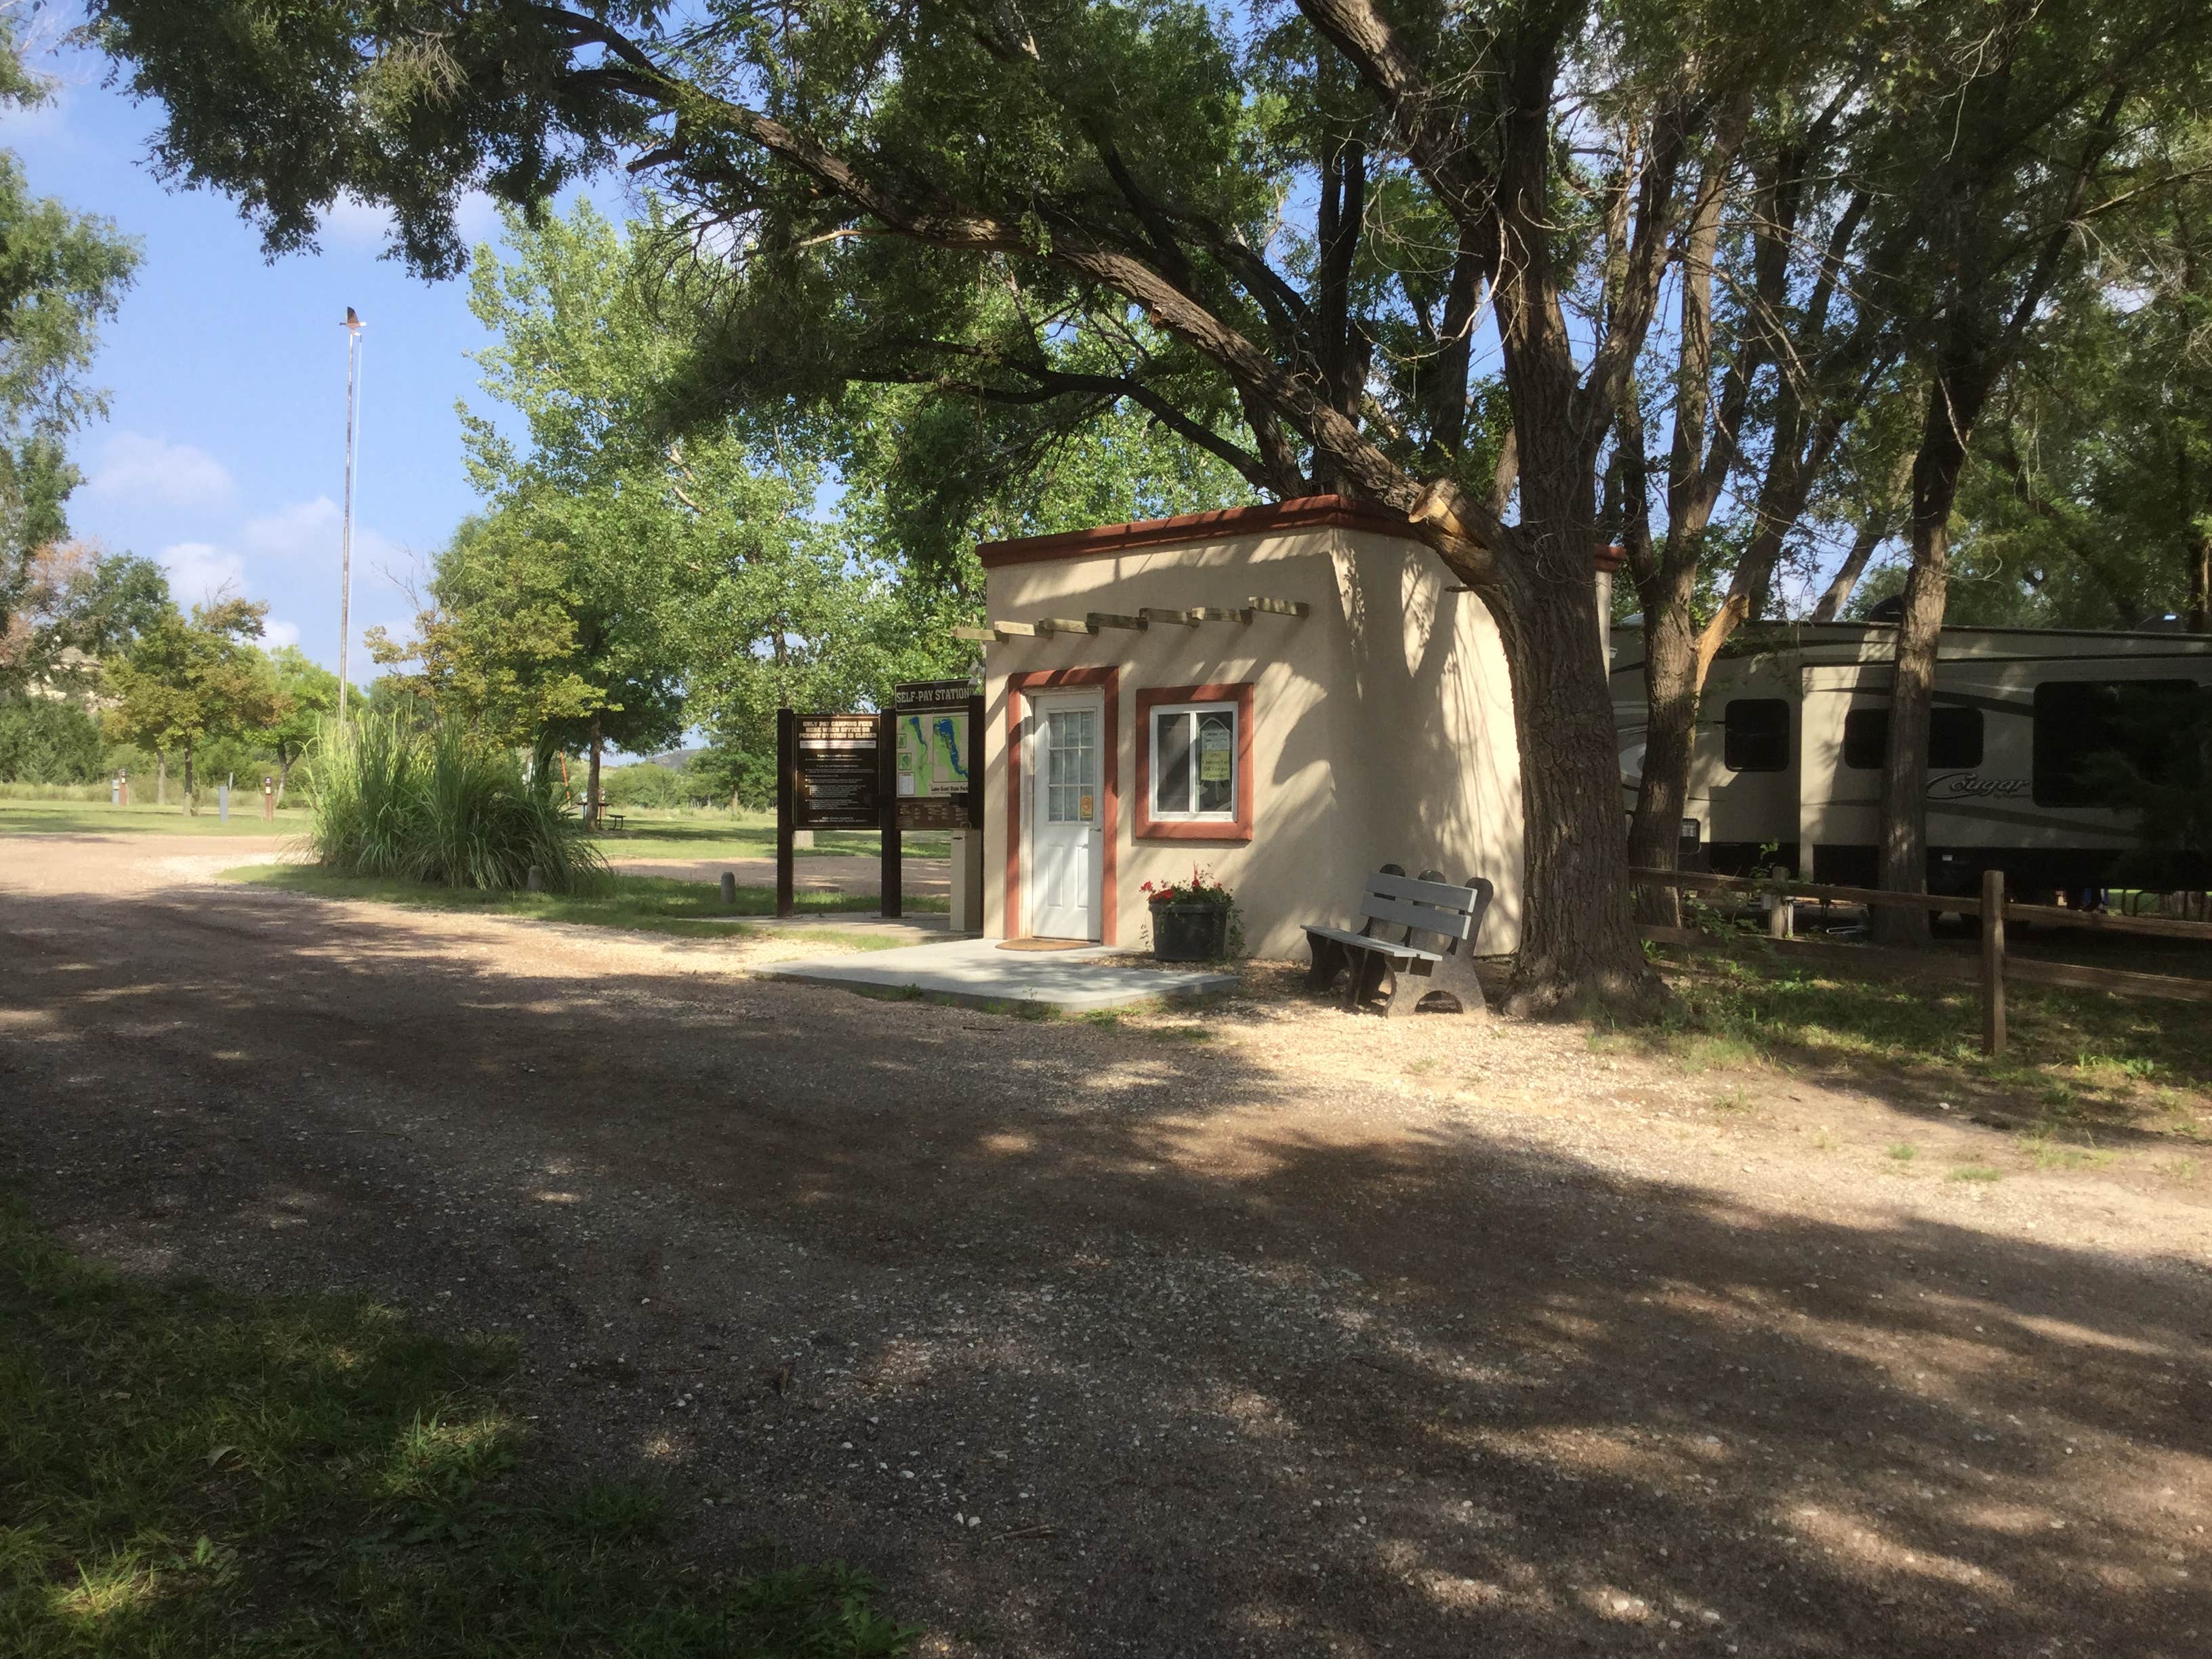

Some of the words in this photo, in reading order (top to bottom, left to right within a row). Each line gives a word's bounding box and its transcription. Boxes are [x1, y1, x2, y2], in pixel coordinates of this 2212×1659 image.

[897, 691, 933, 703] SELF-PAY
[935, 688, 969, 701] STATION
[1925, 773, 2029, 799] Cougar
